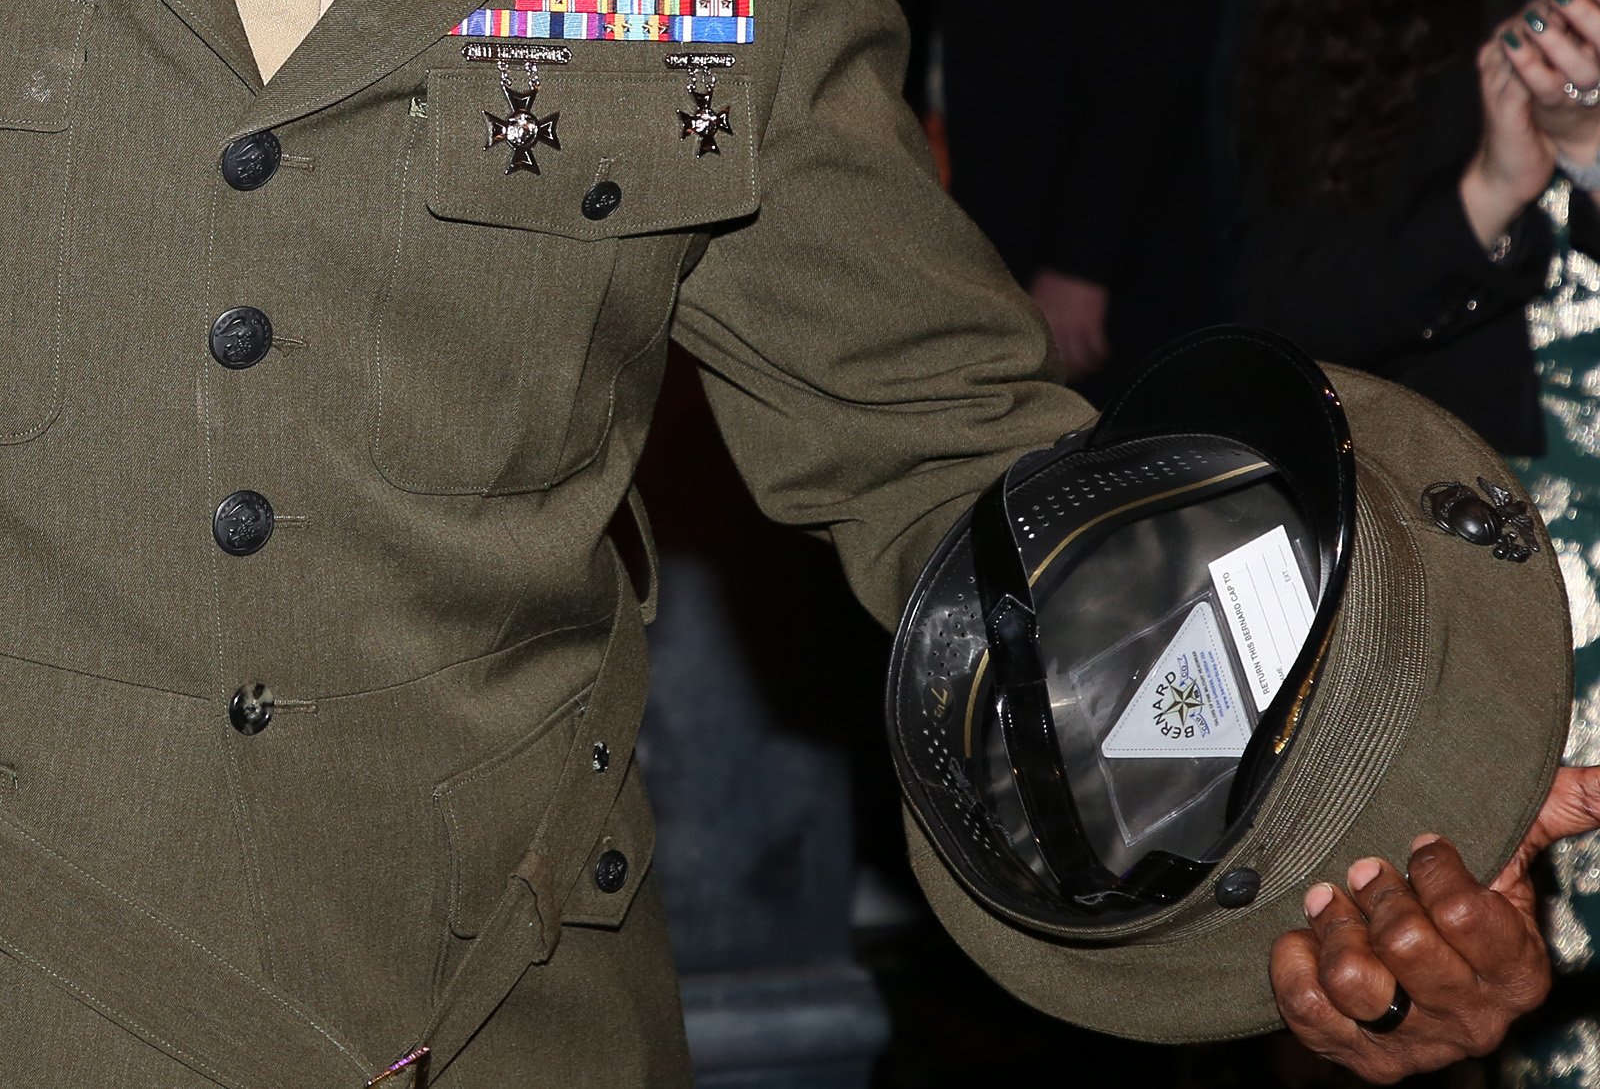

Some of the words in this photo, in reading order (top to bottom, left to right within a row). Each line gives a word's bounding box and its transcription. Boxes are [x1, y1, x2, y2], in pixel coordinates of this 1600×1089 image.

[1222, 572, 1231, 584] TO
[1282, 570, 1291, 582] EXT
[1227, 585, 1238, 602] CAP
[1234, 603, 1252, 641] BERNARD
[1247, 641, 1258, 661] THIS
[1208, 651, 1230, 709] www.bernardcap.com
[1254, 661, 1270, 694] RETURN
[1276, 667, 1286, 682] AME
[1152, 671, 1194, 739] BERNARD
[1196, 717, 1207, 731] CAP
